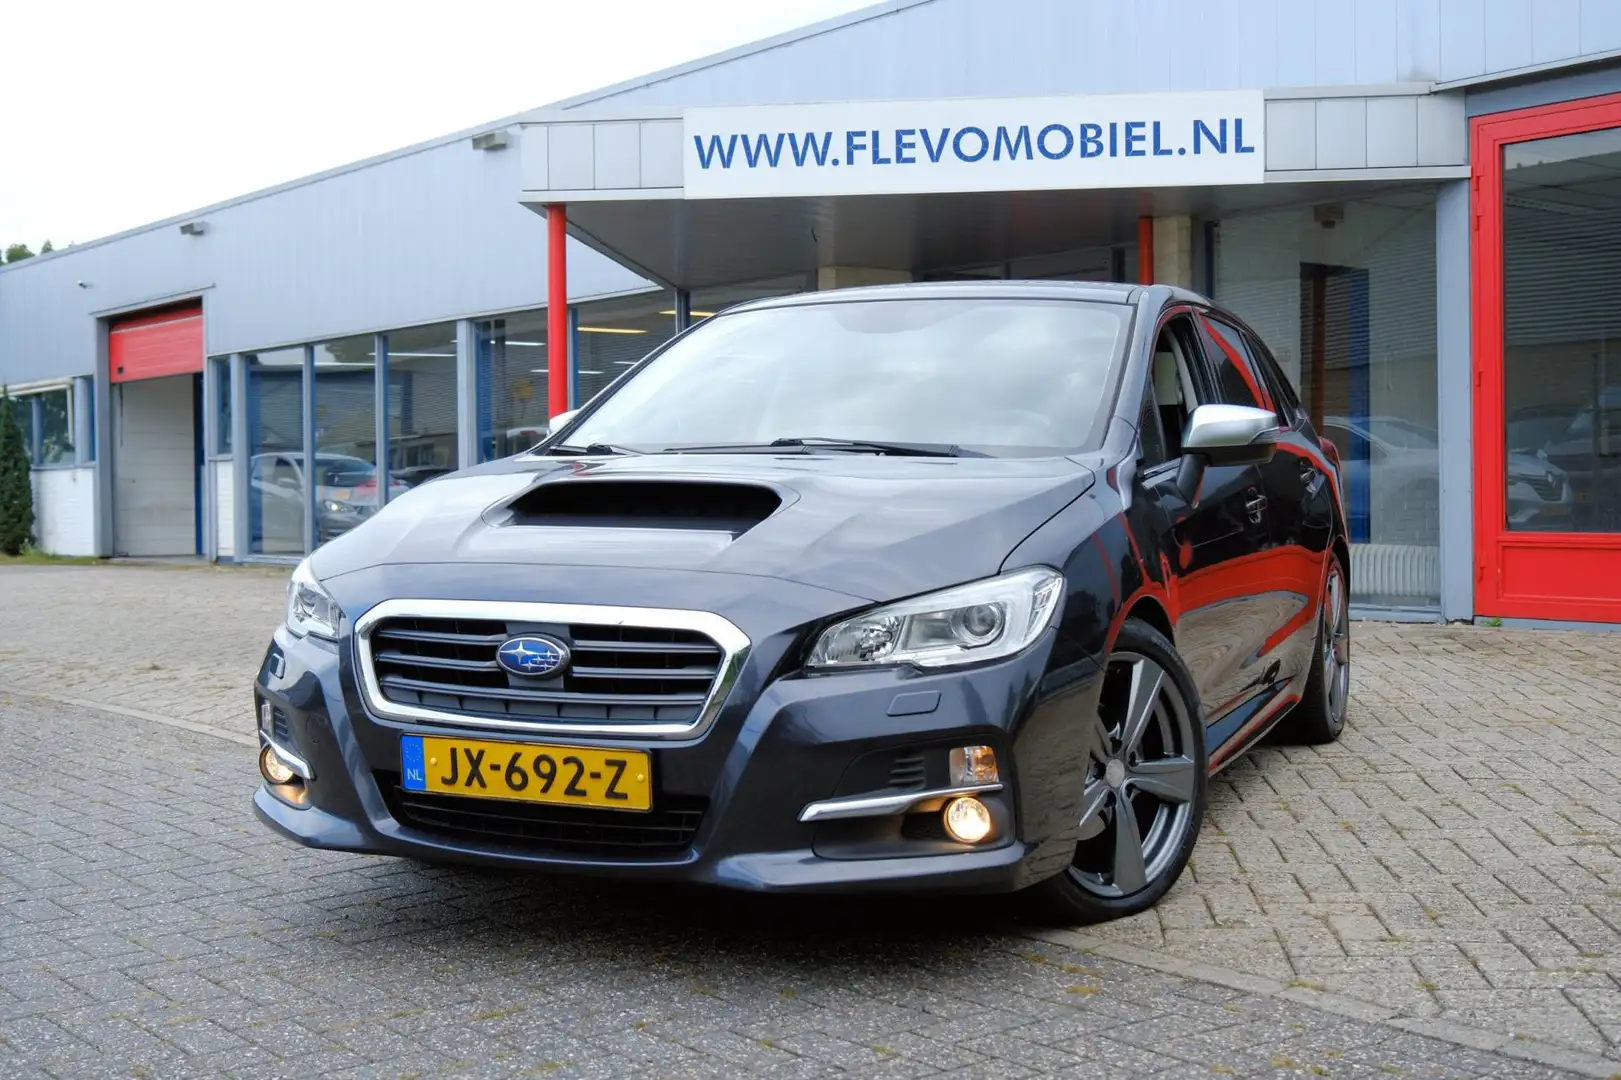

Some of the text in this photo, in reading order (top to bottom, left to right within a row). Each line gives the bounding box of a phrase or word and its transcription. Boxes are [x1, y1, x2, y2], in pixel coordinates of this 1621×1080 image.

[694, 118, 1255, 169] WWW.FLEVOMOBIEL.NL
[406, 768, 423, 782] NL
[441, 747, 629, 800] JX-692-Z
